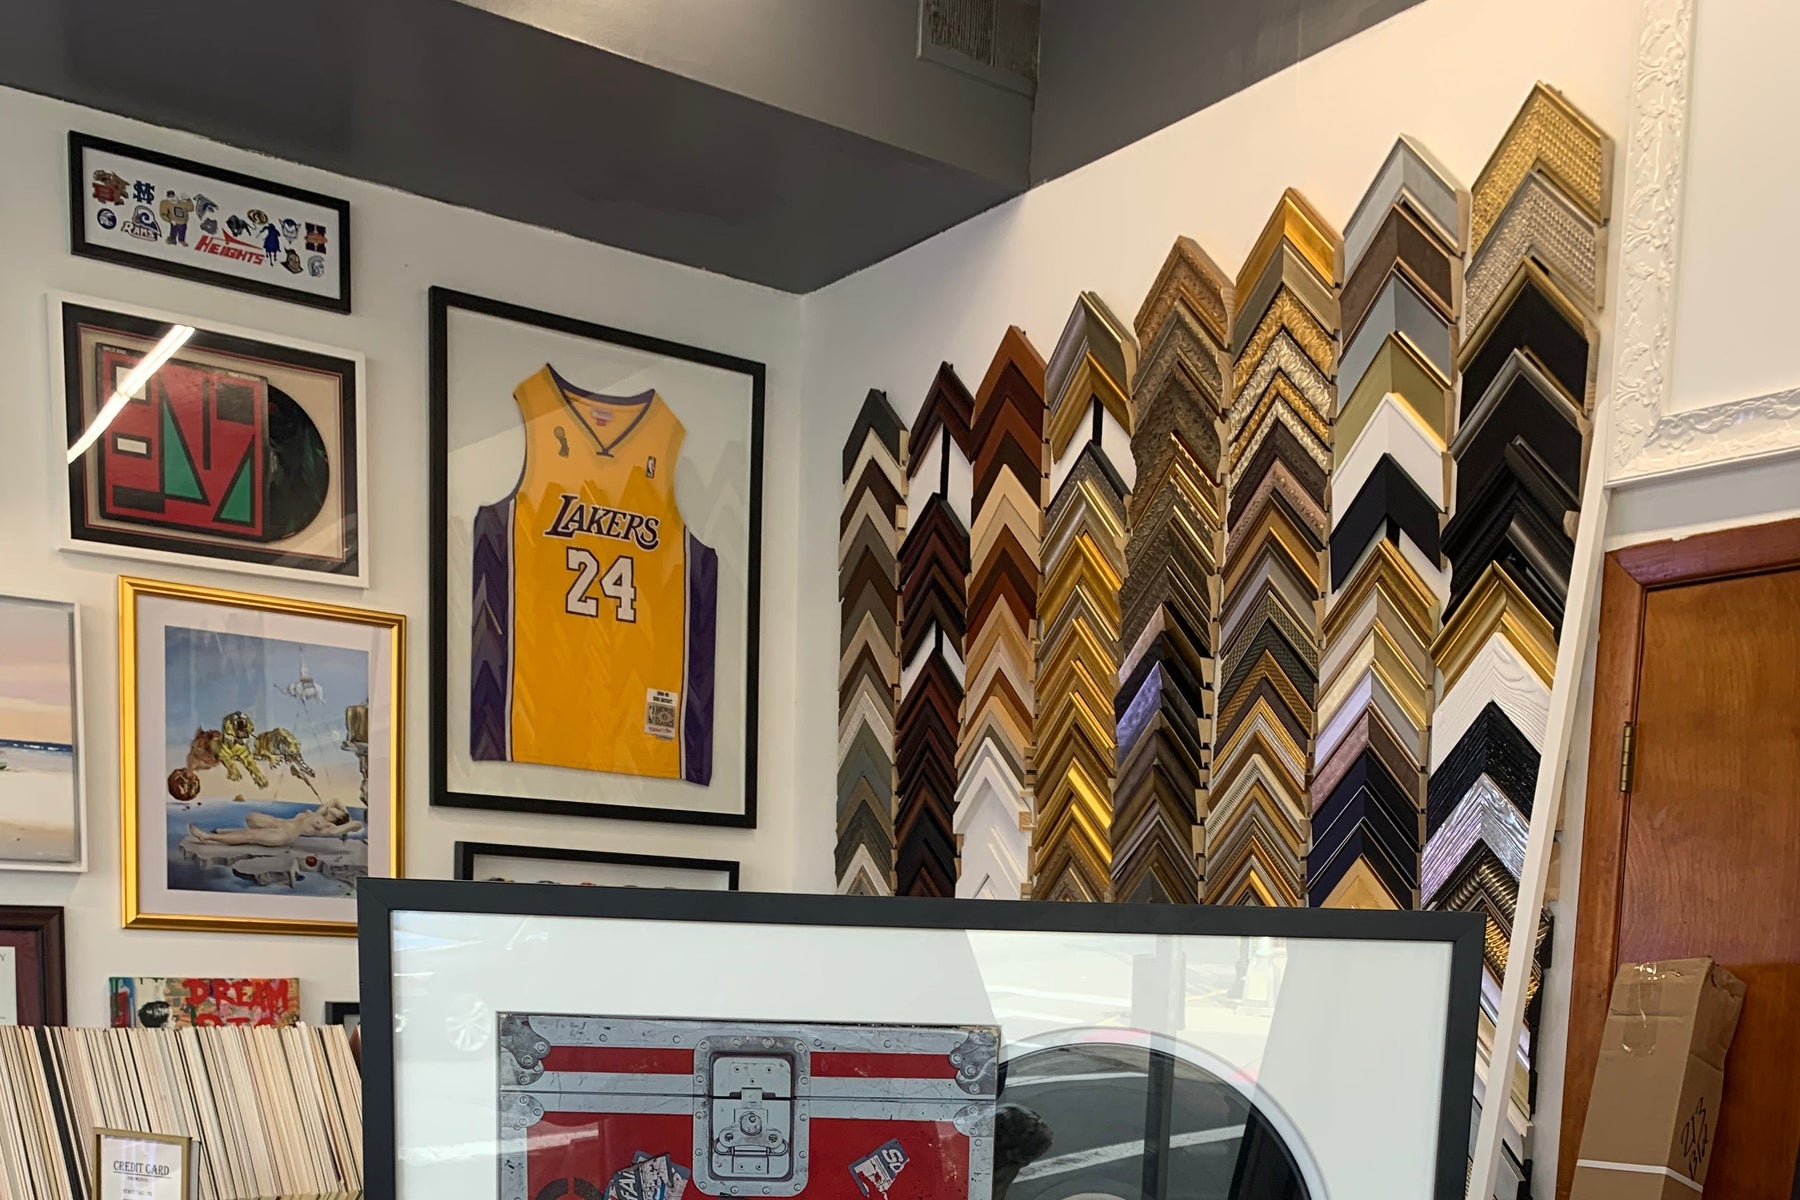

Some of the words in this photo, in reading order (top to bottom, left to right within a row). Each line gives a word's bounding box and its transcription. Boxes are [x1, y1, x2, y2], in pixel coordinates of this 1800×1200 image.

[543, 494, 660, 551] LAKERS
[565, 546, 637, 624] 24
[183, 979, 289, 1018] DREAM
[113, 1160, 144, 1174] CREDIT
[145, 1164, 170, 1176] CARD
